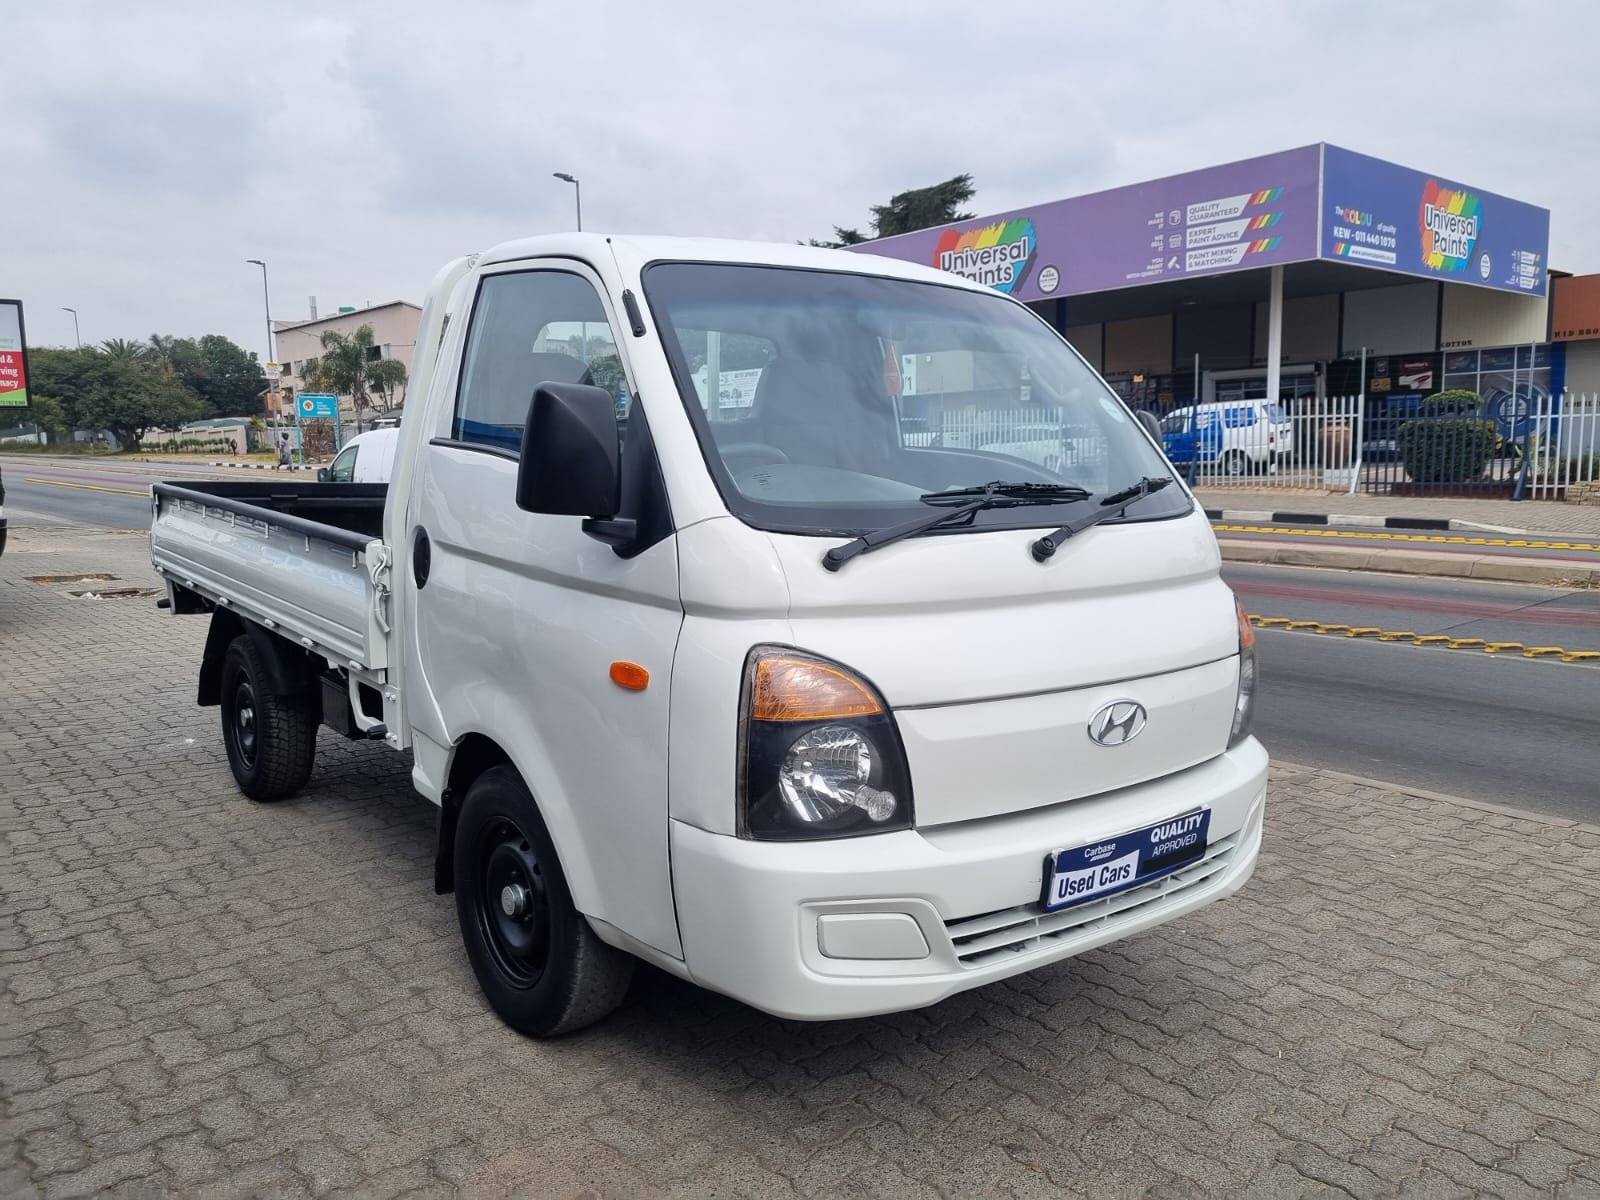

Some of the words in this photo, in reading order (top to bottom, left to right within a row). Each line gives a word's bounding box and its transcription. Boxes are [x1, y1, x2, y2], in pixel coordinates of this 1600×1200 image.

[1189, 203, 1220, 215] QUALITY
[1189, 207, 1239, 222] GUARANTEED
[1344, 208, 1374, 228] COLOU
[1425, 205, 1477, 237] Universal
[1188, 236, 1210, 246] PAINT
[1211, 231, 1239, 242] ADVICE
[1189, 227, 1216, 238] EXPERT
[1333, 225, 1351, 240] KEW
[1355, 230, 1366, 243] 011
[1366, 233, 1380, 246] 440
[1380, 235, 1397, 249] 1070
[1433, 231, 1467, 257] Paints
[942, 238, 1027, 272] Universal
[1188, 251, 1210, 261] PAINT
[1210, 247, 1238, 257] MIXING
[1194, 255, 1233, 268] MATCHING
[6, 355, 14, 364] &
[1150, 813, 1204, 843] QUALITY
[1084, 842, 1116, 858] Carbase
[1151, 833, 1197, 858] APPROVED
[1058, 870, 1096, 899] Used
[1099, 863, 1131, 886] Cars
